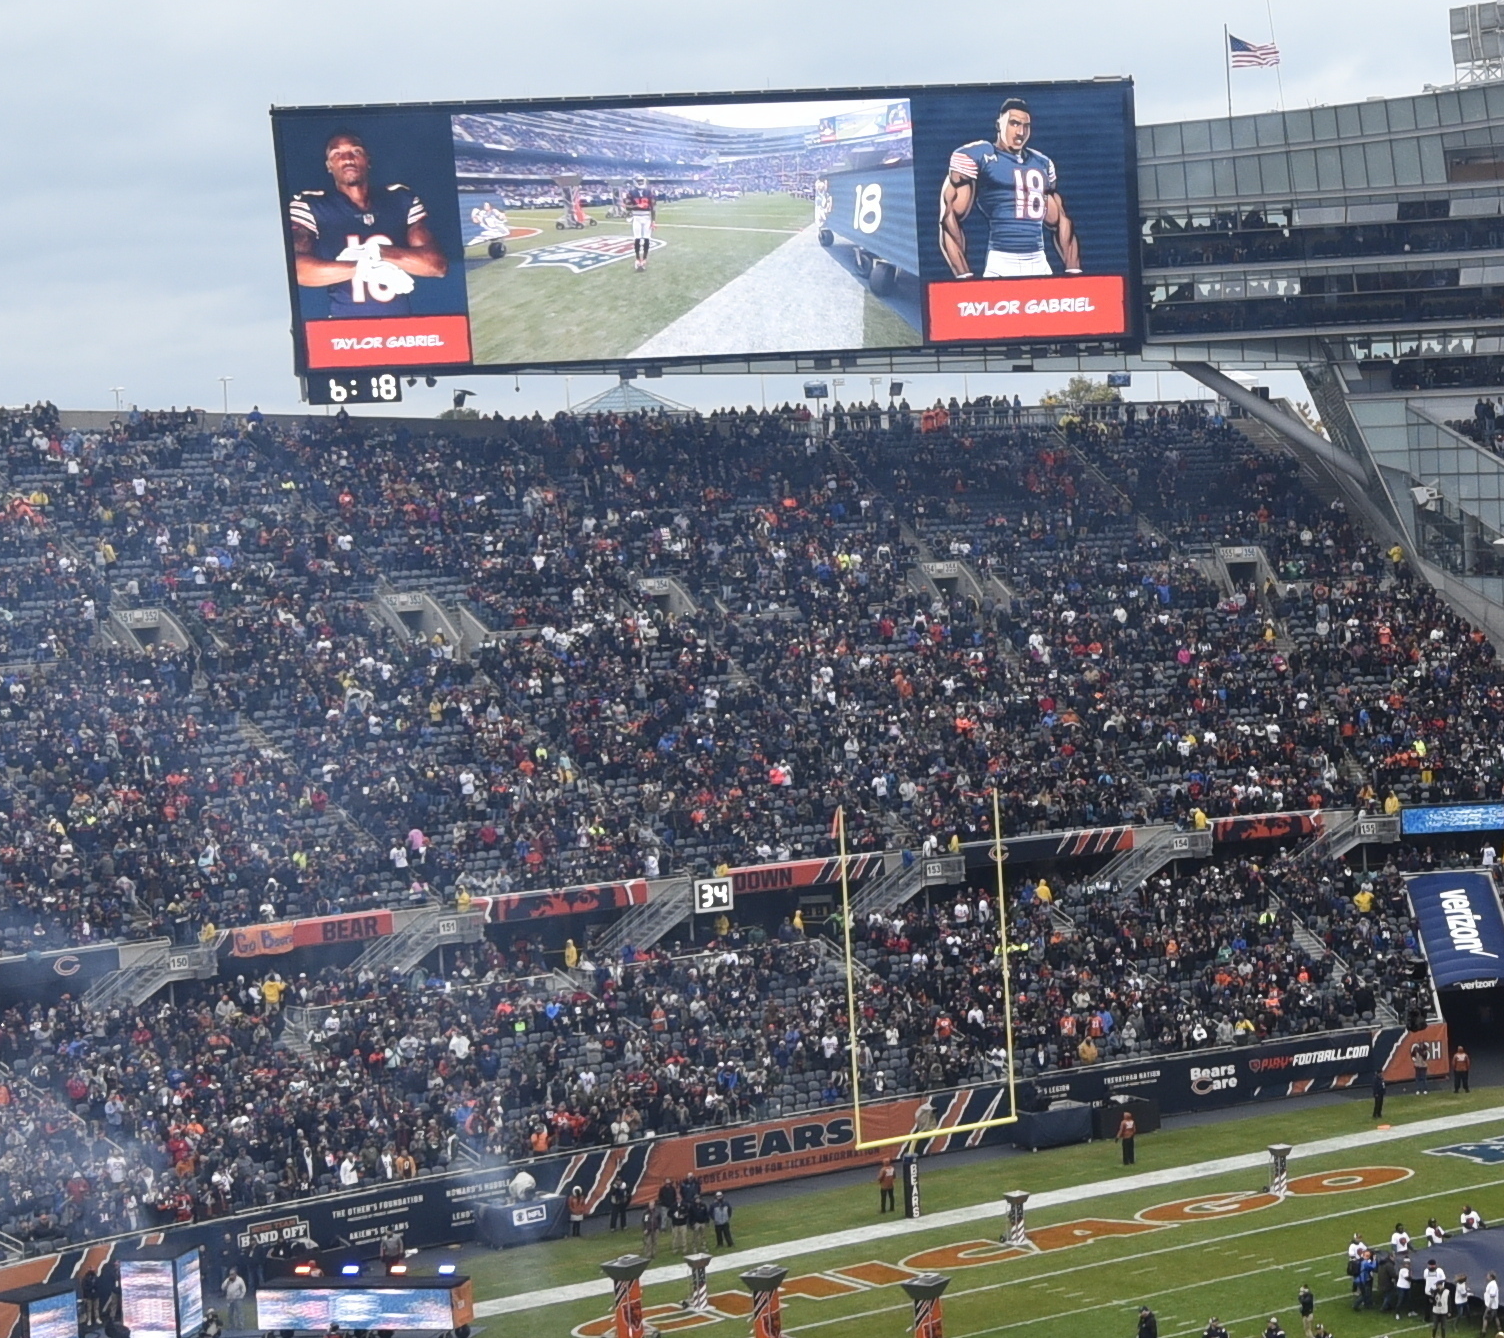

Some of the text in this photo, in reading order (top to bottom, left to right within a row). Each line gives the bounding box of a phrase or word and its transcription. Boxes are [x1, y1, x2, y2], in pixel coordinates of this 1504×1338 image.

[1013, 167, 1046, 219] 18
[853, 182, 883, 234] 18
[956, 297, 1096, 318] TAYLOR GABRIEL
[330, 333, 445, 351] TAYLOR GABRIEL
[700, 883, 729, 908] 34
[321, 915, 379, 942] BEAR
[441, 921, 456, 932] 151
[1440, 889, 1484, 953] verizon
[171, 955, 187, 967] 150
[1190, 1064, 1236, 1081] Bears
[693, 1117, 856, 1171] BEARS
[909, 1163, 920, 1218] BEARS
